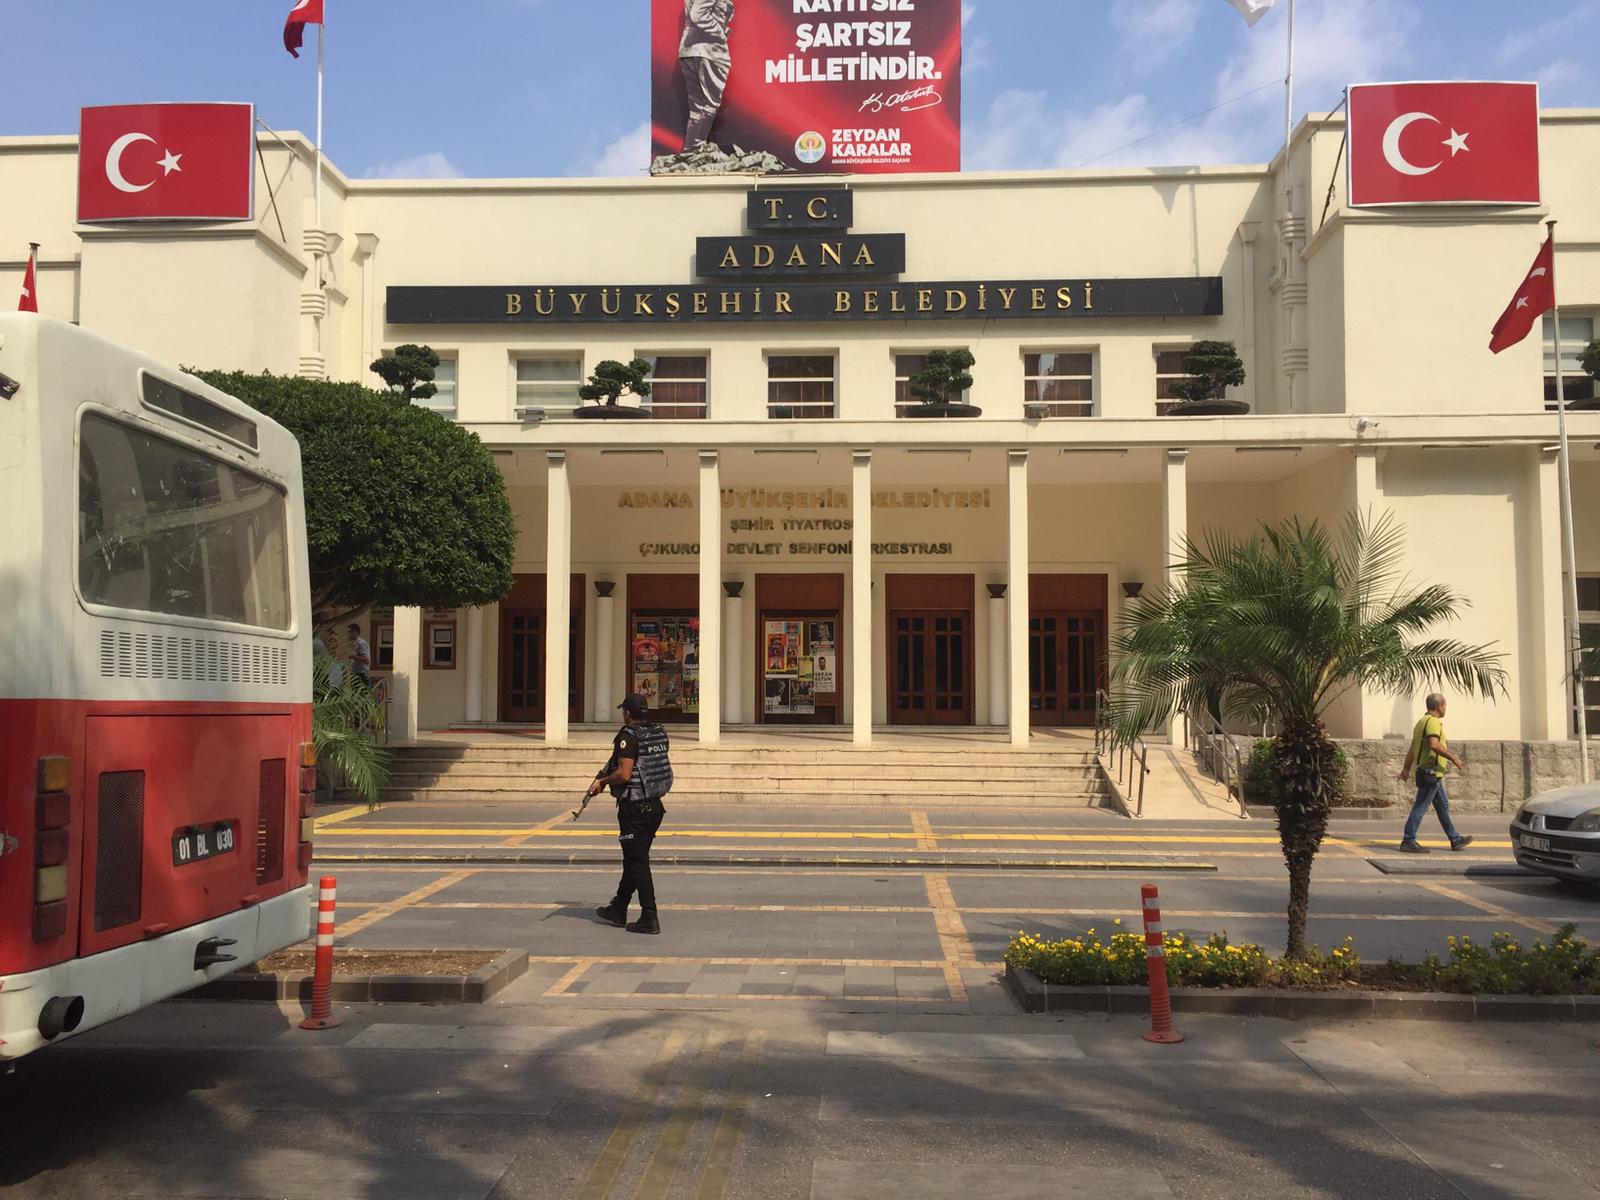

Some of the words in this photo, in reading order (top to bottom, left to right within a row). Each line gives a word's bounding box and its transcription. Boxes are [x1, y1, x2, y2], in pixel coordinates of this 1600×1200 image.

[796, 21, 912, 52] ŞARTSIZ
[765, 51, 942, 83] MİLLETİNDİR.
[832, 127, 900, 142] ZEYDAN
[832, 142, 912, 157] KARALAR
[719, 242, 875, 268] ADANA
[505, 287, 793, 318] BÜYÜKŞEHİR
[835, 282, 1093, 312] BELEDİYESİ
[618, 492, 694, 508] ADANA
[719, 488, 849, 511] ÜYÜKŞEHİR
[871, 488, 990, 508] ELEDİYESİ
[730, 517, 774, 533] ŞEHİR
[782, 516, 853, 531] TİYATROS
[639, 542, 700, 557] ÇUKURO
[726, 542, 783, 555] DEVLET
[871, 542, 952, 555] RKESTRASI
[179, 836, 191, 860] 01
[197, 833, 209, 857] BL
